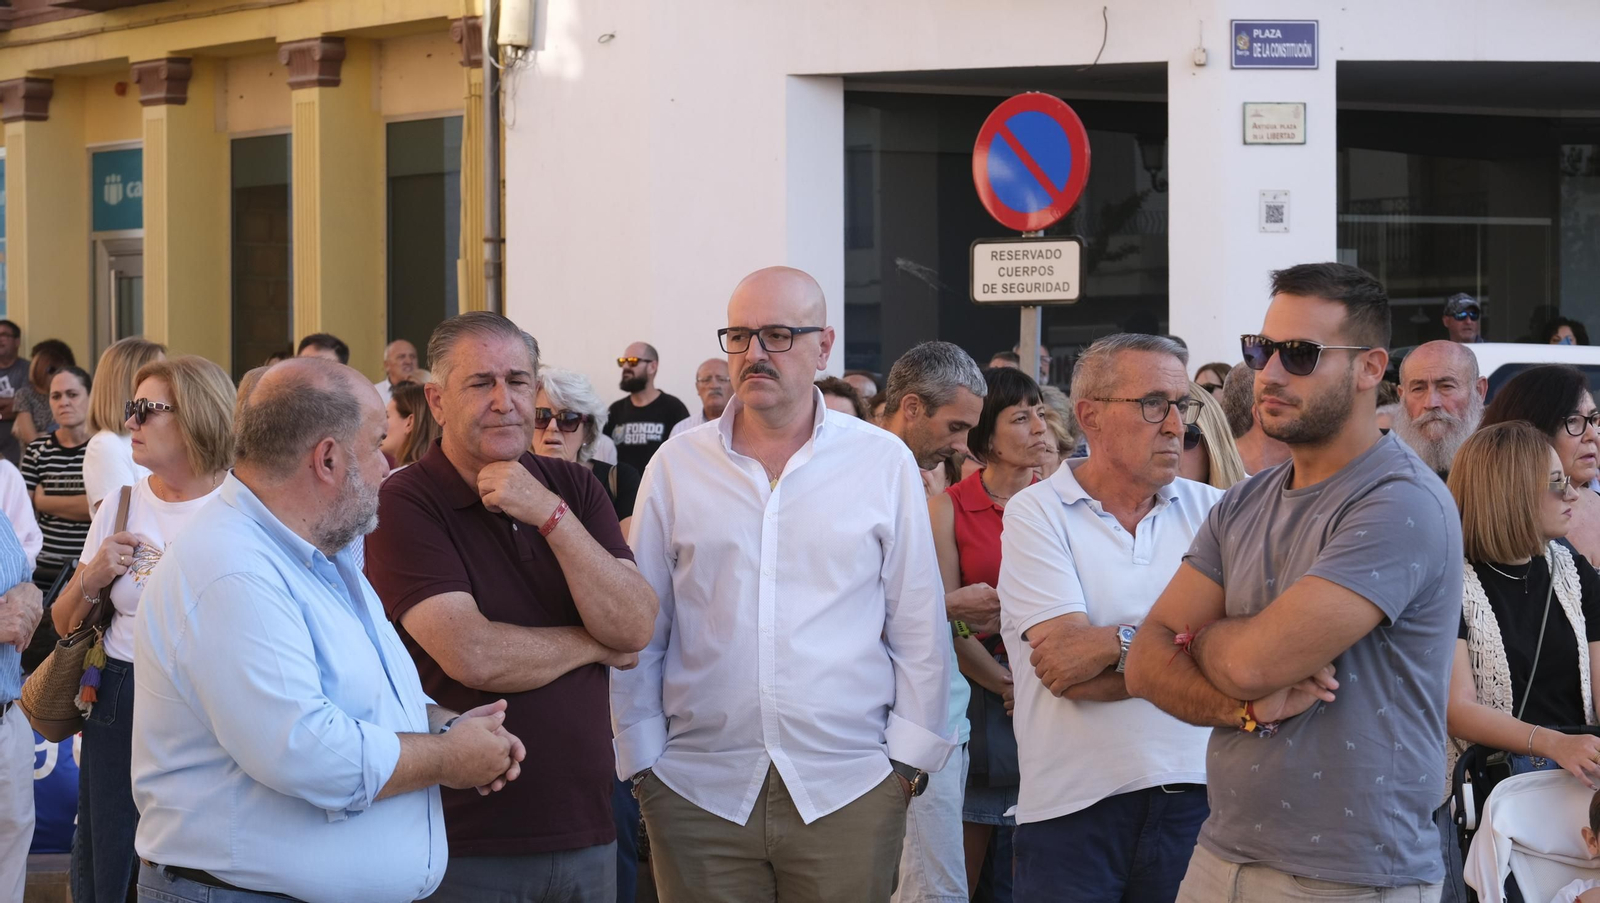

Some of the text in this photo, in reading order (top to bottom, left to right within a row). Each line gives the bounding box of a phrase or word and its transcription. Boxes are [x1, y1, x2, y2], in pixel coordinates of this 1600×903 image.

[1253, 29, 1282, 38] PLAZA
[1253, 40, 1312, 58] DE LA CONSTITUCIÓN
[1266, 132, 1296, 140] LIBERTAD
[990, 248, 1062, 261] RESERVADO
[998, 265, 1054, 277] CUERPOS
[982, 281, 1070, 294] DE SEGURIDAD
[625, 423, 664, 434] FONDO
[624, 433, 647, 445] SUR
